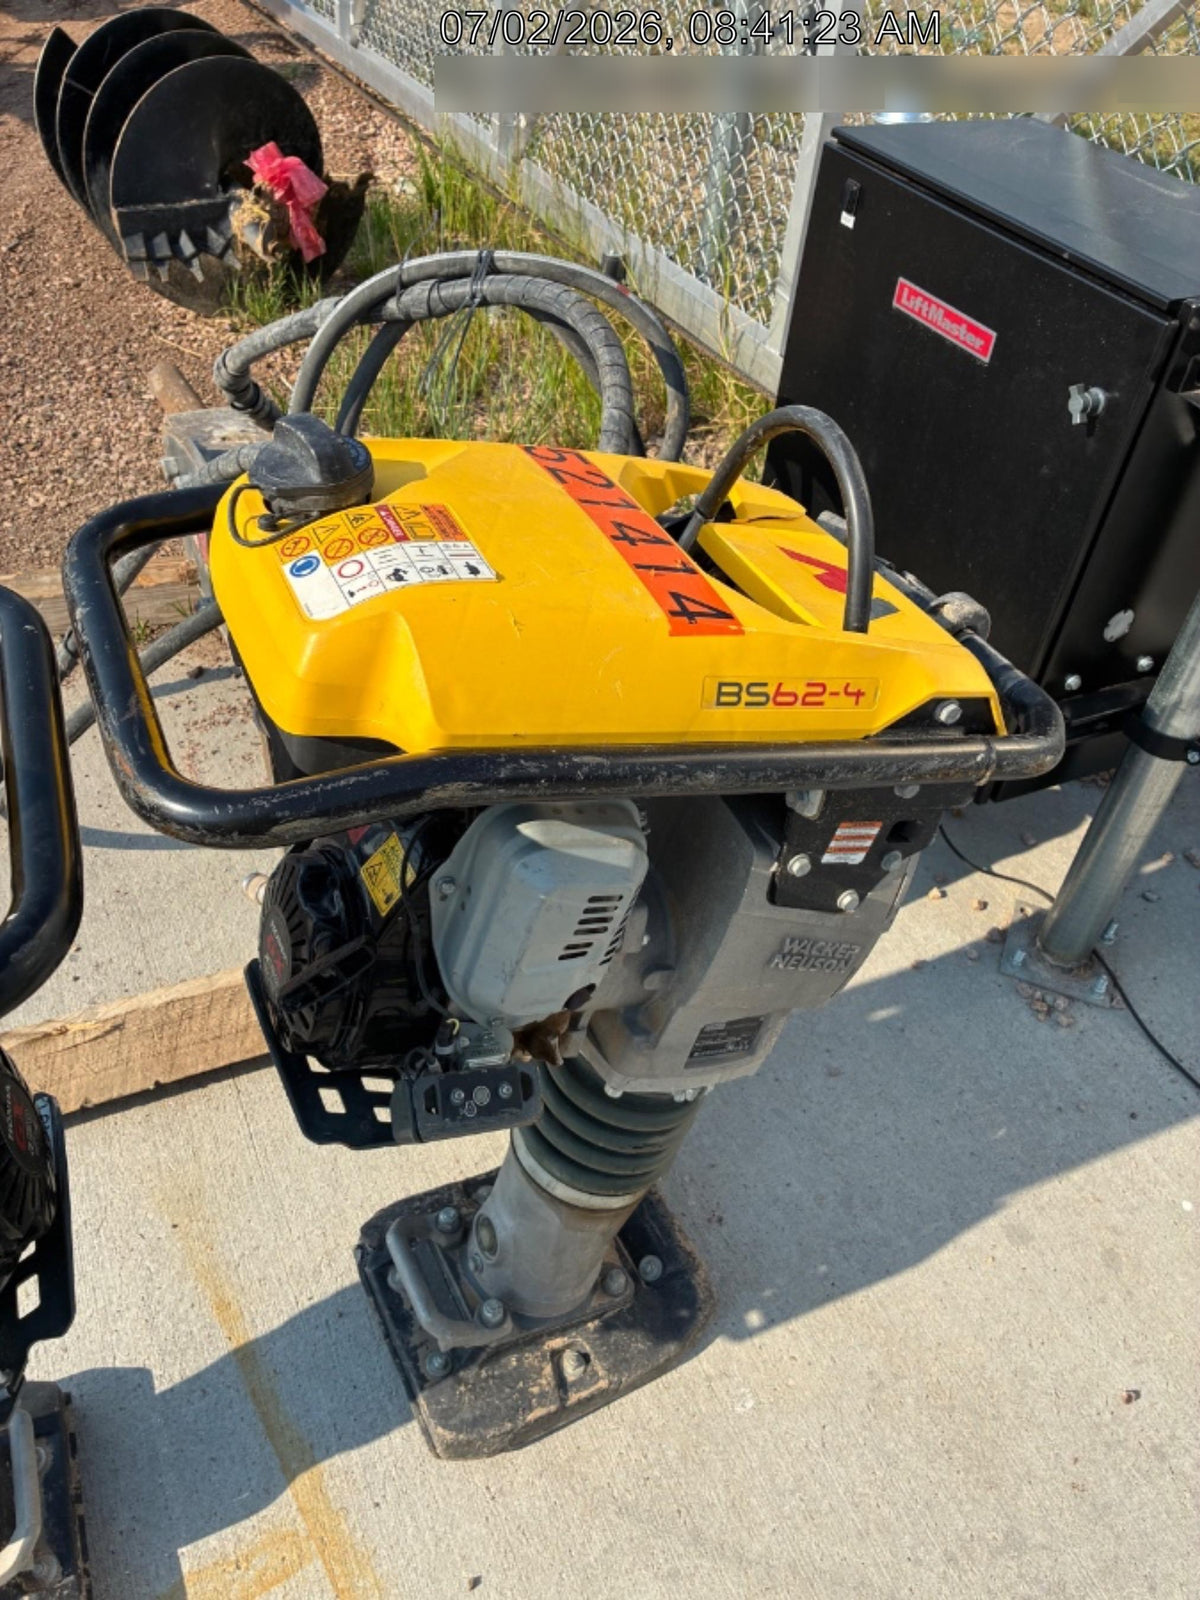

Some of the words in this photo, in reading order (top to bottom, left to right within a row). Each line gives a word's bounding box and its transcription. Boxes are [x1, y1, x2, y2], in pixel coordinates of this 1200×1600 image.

[901, 286, 985, 350] LiftMaster
[524, 446, 735, 625] 521414
[715, 681, 866, 707] BS62-4
[782, 937, 862, 959] WACKER
[769, 953, 855, 974] NEUSON
